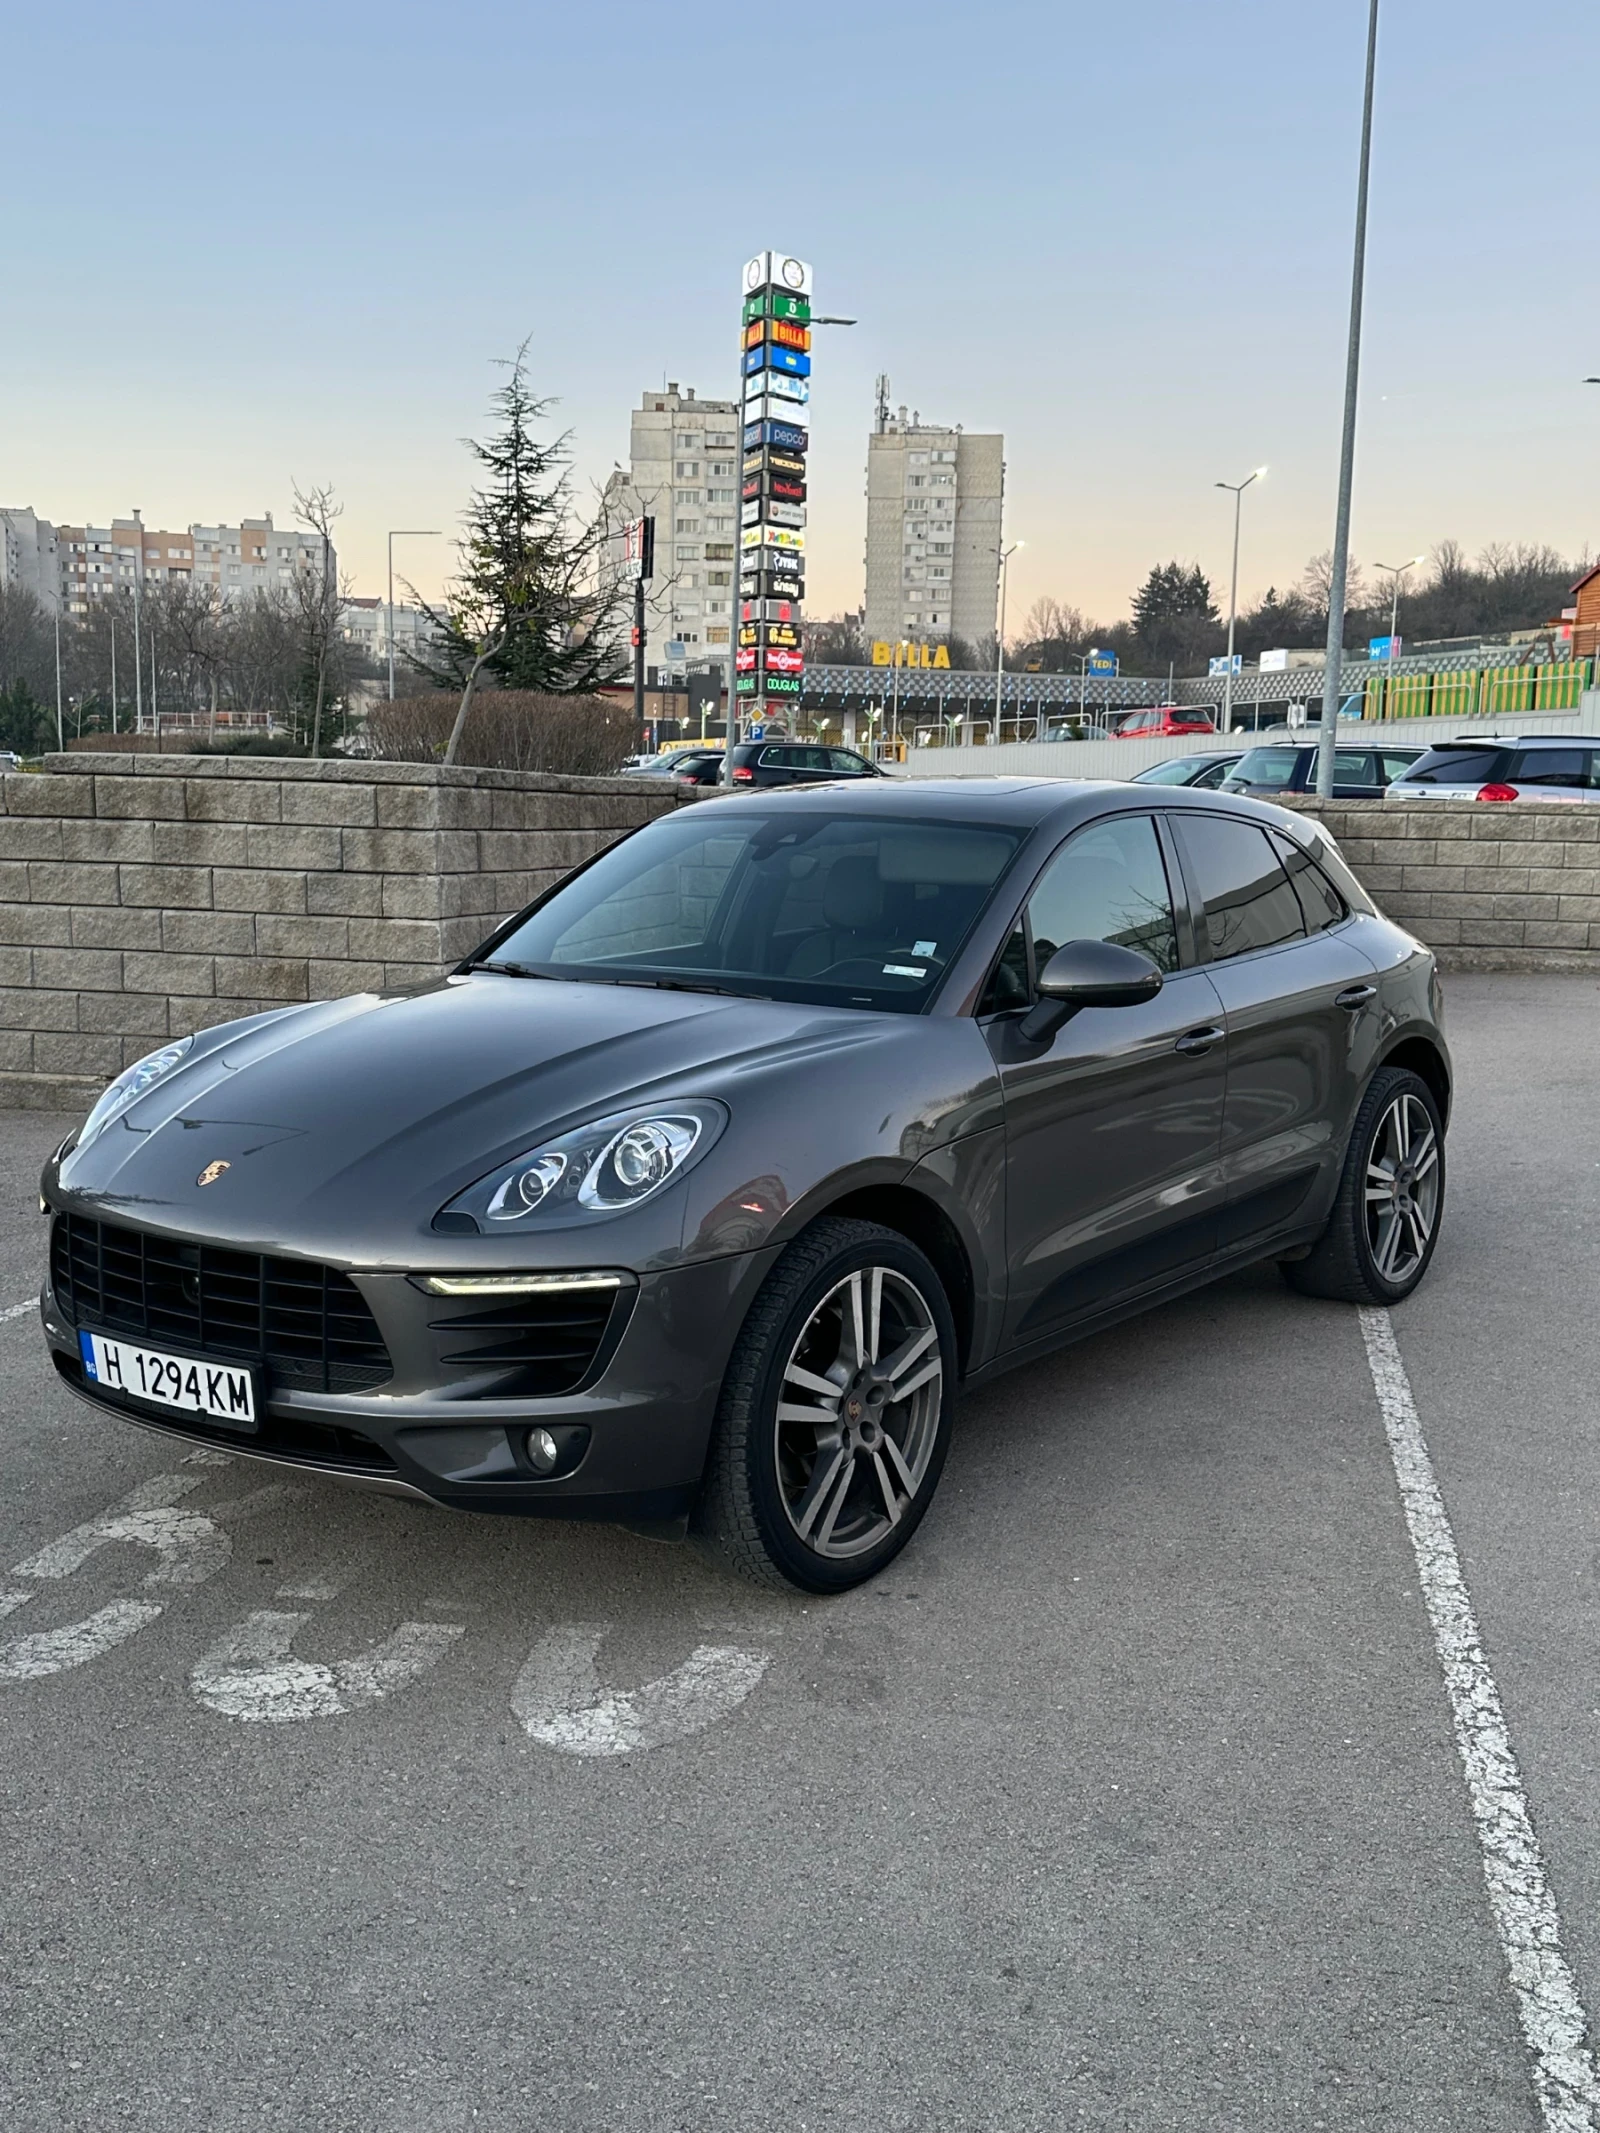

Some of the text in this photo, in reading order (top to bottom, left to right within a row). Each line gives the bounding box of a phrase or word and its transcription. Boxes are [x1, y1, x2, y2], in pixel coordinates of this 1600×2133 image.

[779, 326, 804, 346] BILLA
[774, 429, 804, 446] pepco
[778, 556, 798, 570] JYSK
[773, 578, 799, 598] sinsay
[872, 641, 951, 669] BILLA
[767, 678, 800, 692] DOUGLAS
[751, 730, 760, 739] P
[85, 1360, 97, 1375] BG
[103, 1343, 250, 1416] H 1294KM
